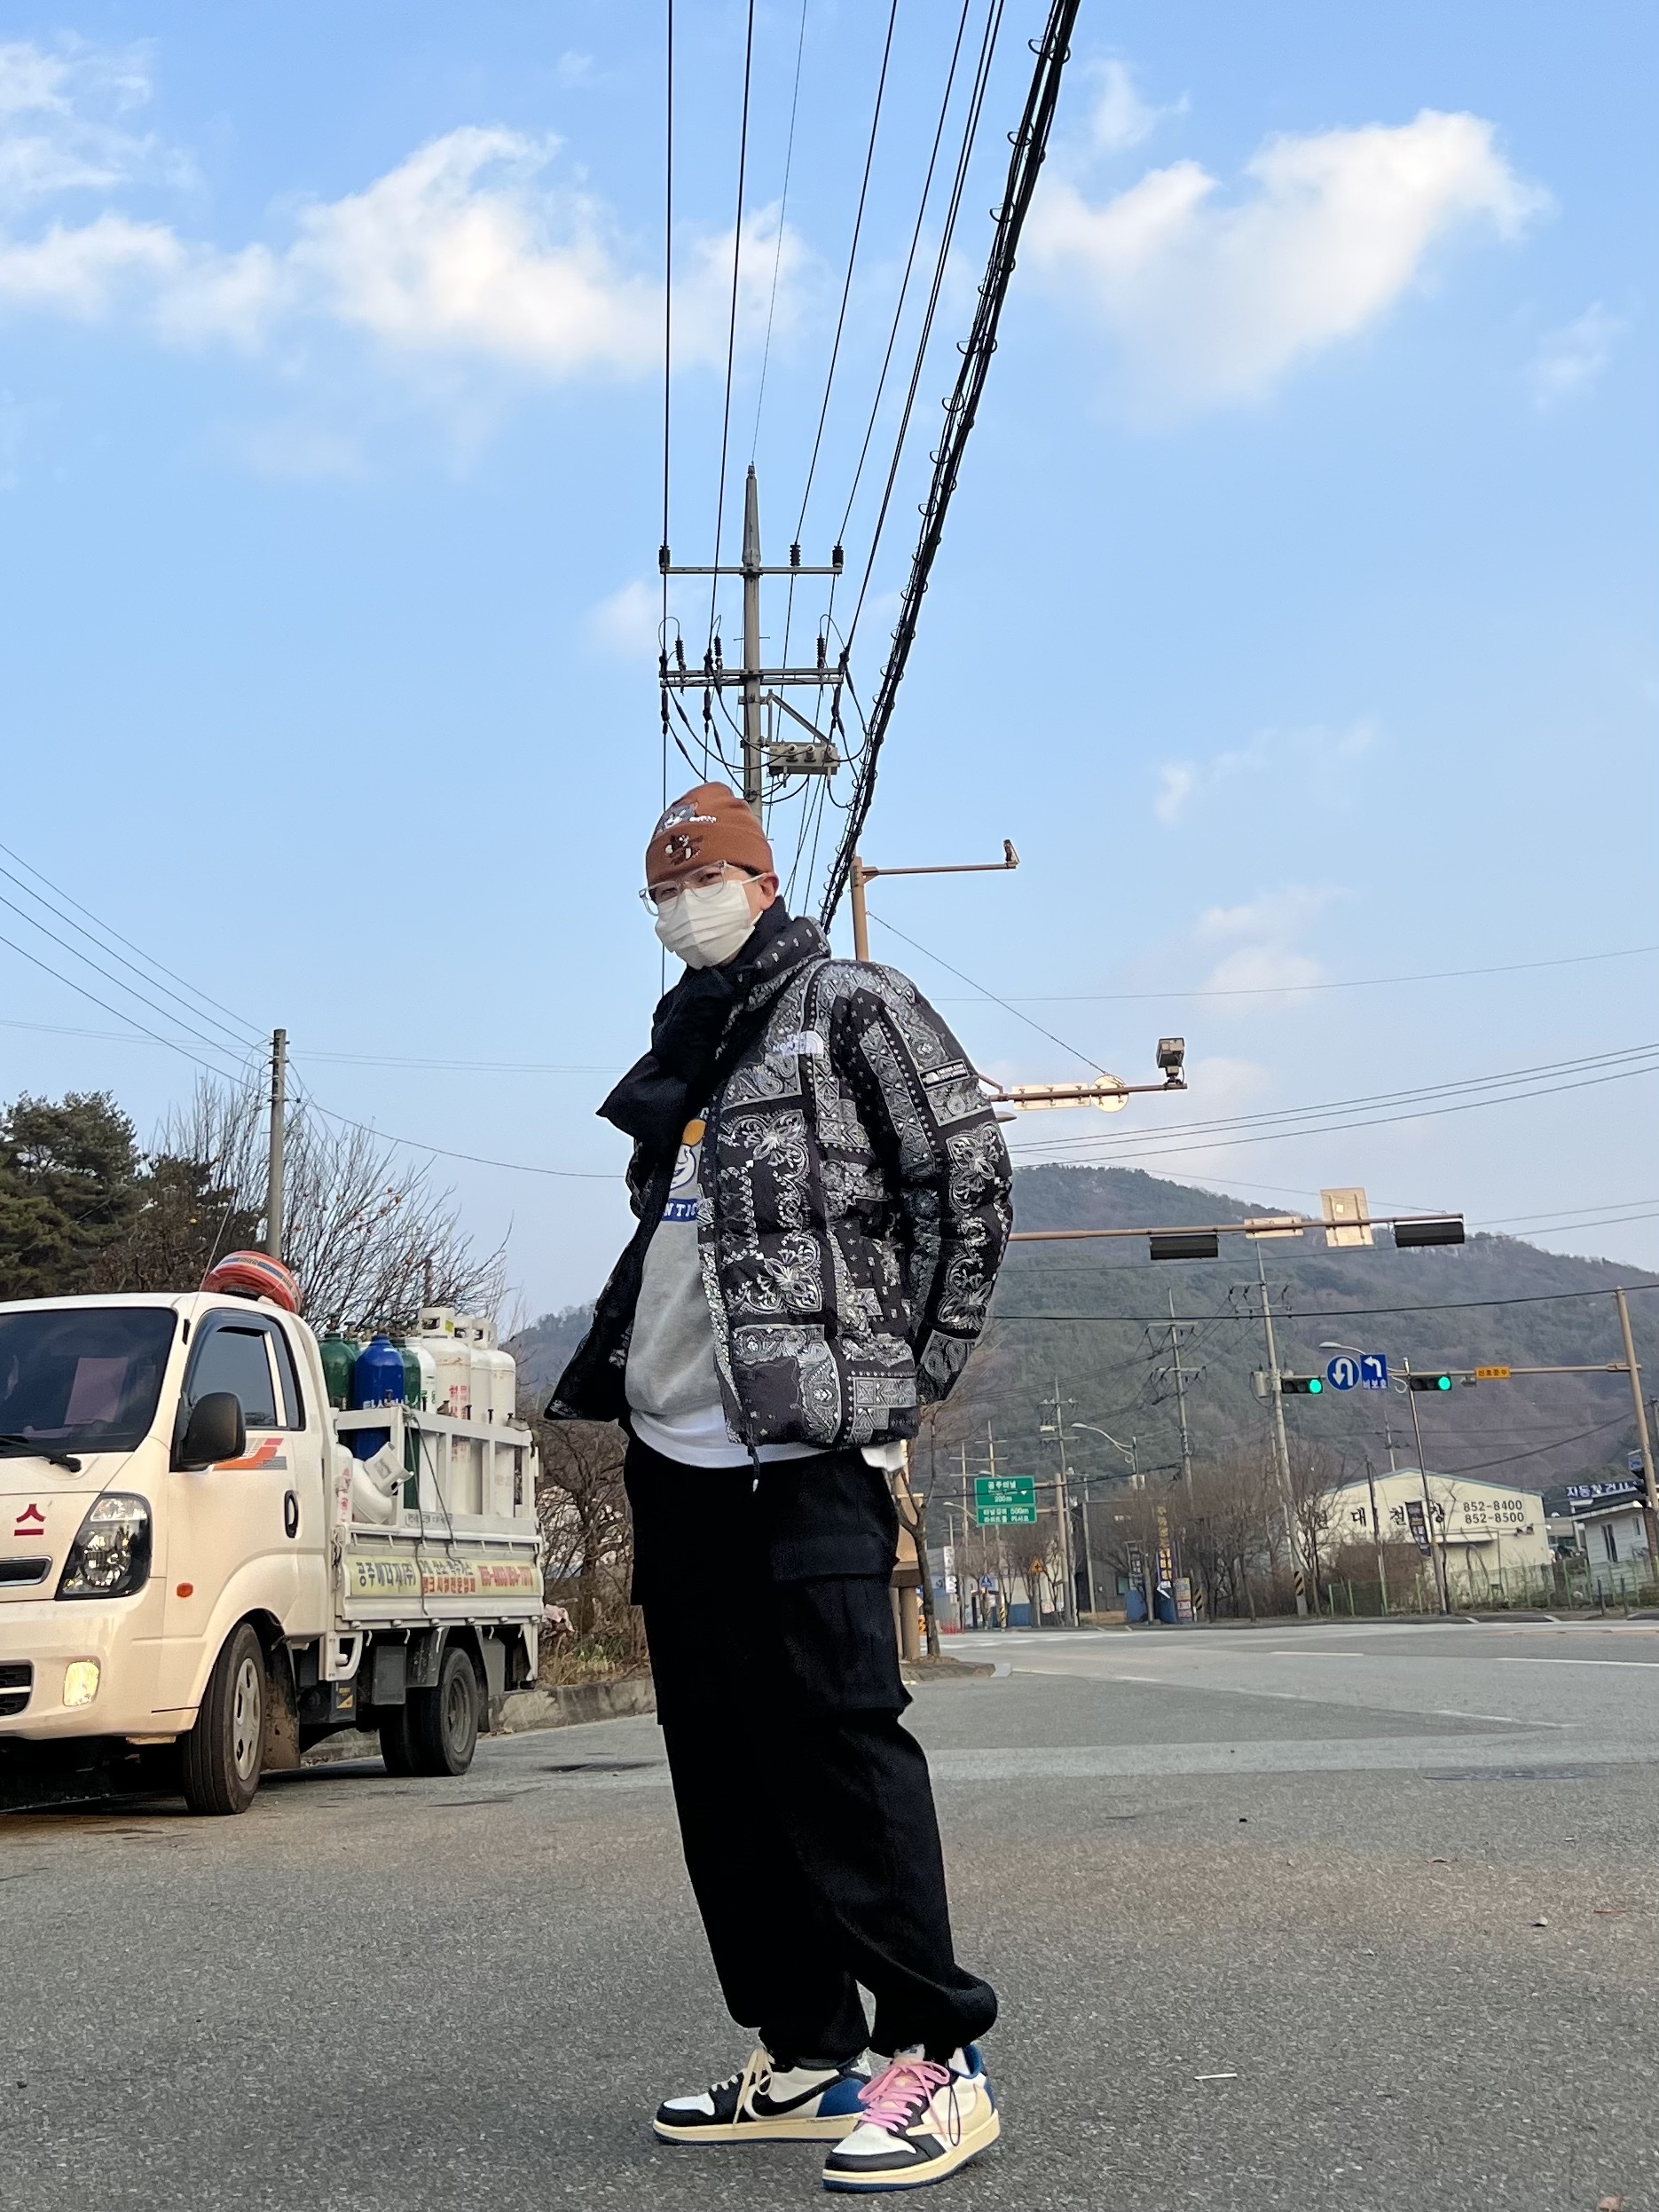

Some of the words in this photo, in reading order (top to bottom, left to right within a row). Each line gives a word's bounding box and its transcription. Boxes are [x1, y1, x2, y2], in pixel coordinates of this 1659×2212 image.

[1363, 1379, 1388, 1389] 비보호
[1463, 1500, 1523, 1513] 852-8400
[14, 1503, 46, 1537] 스
[1465, 1512, 1525, 1524] 852-8500
